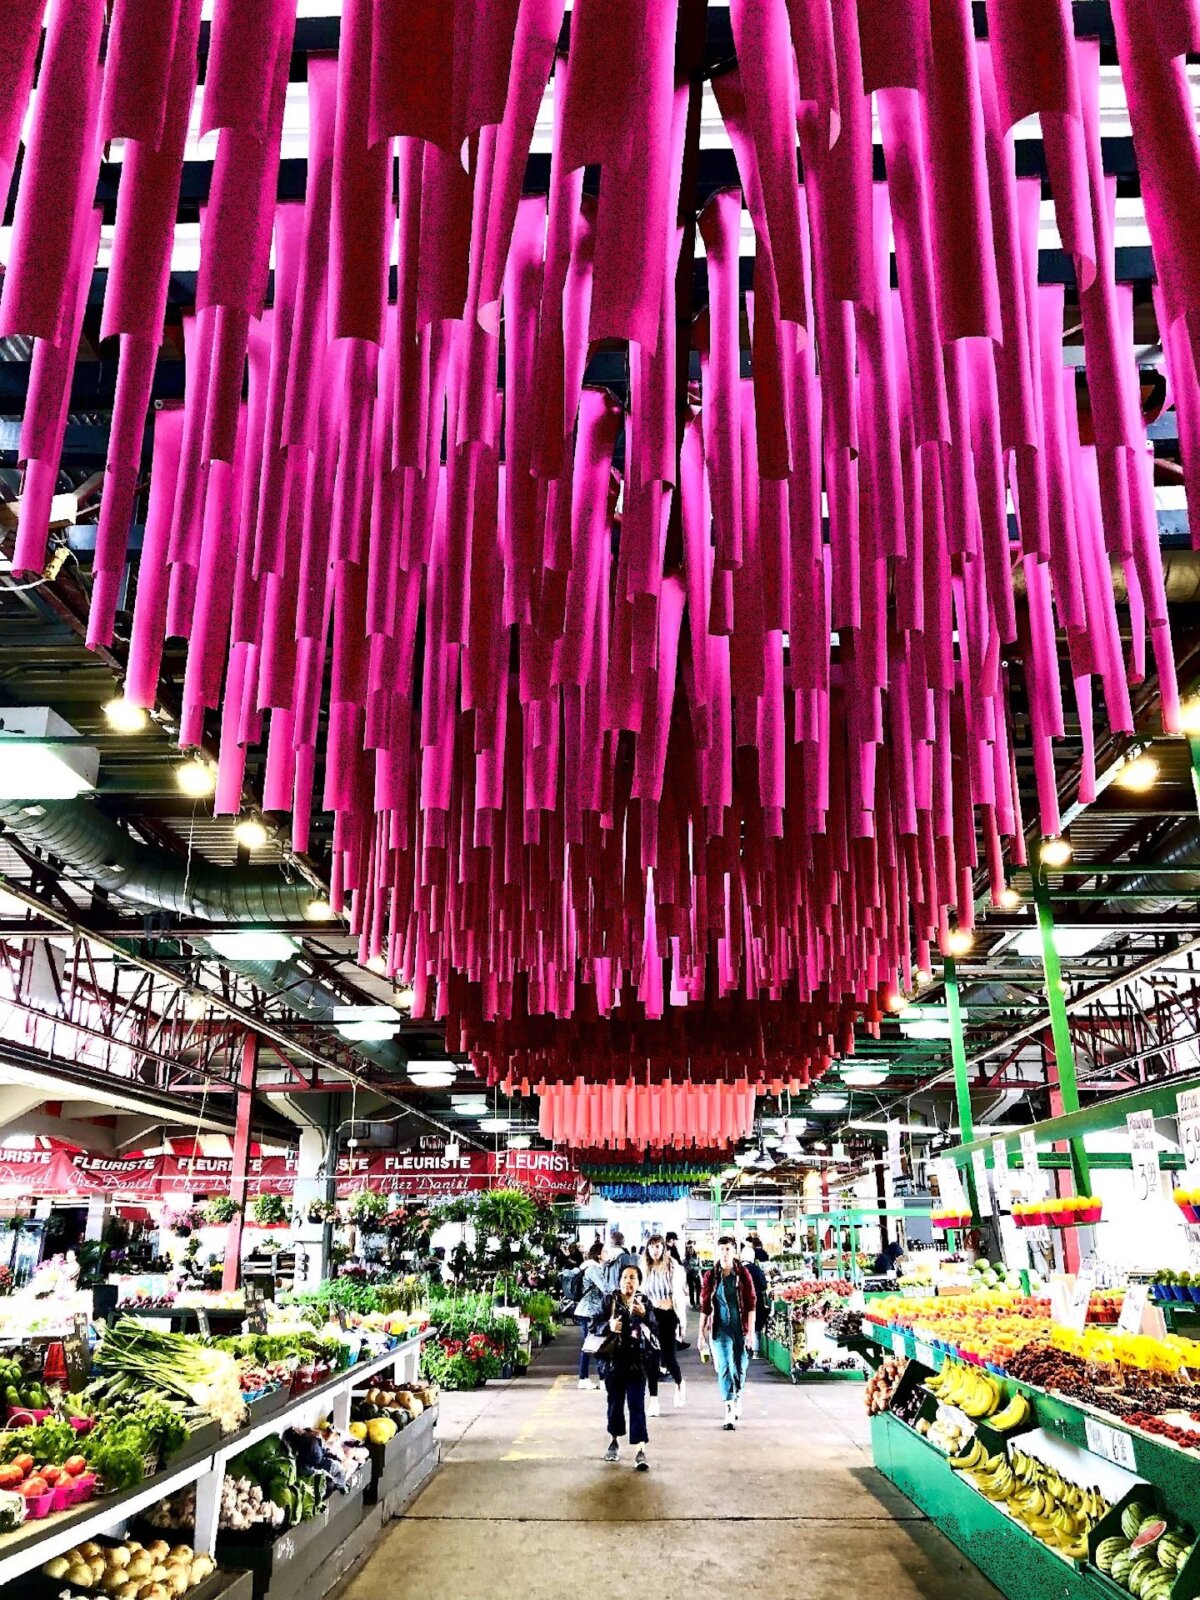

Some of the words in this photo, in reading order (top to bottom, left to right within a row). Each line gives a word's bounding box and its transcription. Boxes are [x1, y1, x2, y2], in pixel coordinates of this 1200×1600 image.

[72, 1156, 155, 1171] FLEURISTE
[385, 1157, 471, 1169] FLEURISTE
[66, 1170, 99, 1188] Chez
[101, 1173, 155, 1192] Daniel
[381, 1174, 412, 1189] Chez
[416, 1176, 470, 1190] Daniel
[534, 1174, 577, 1191] Daniel
